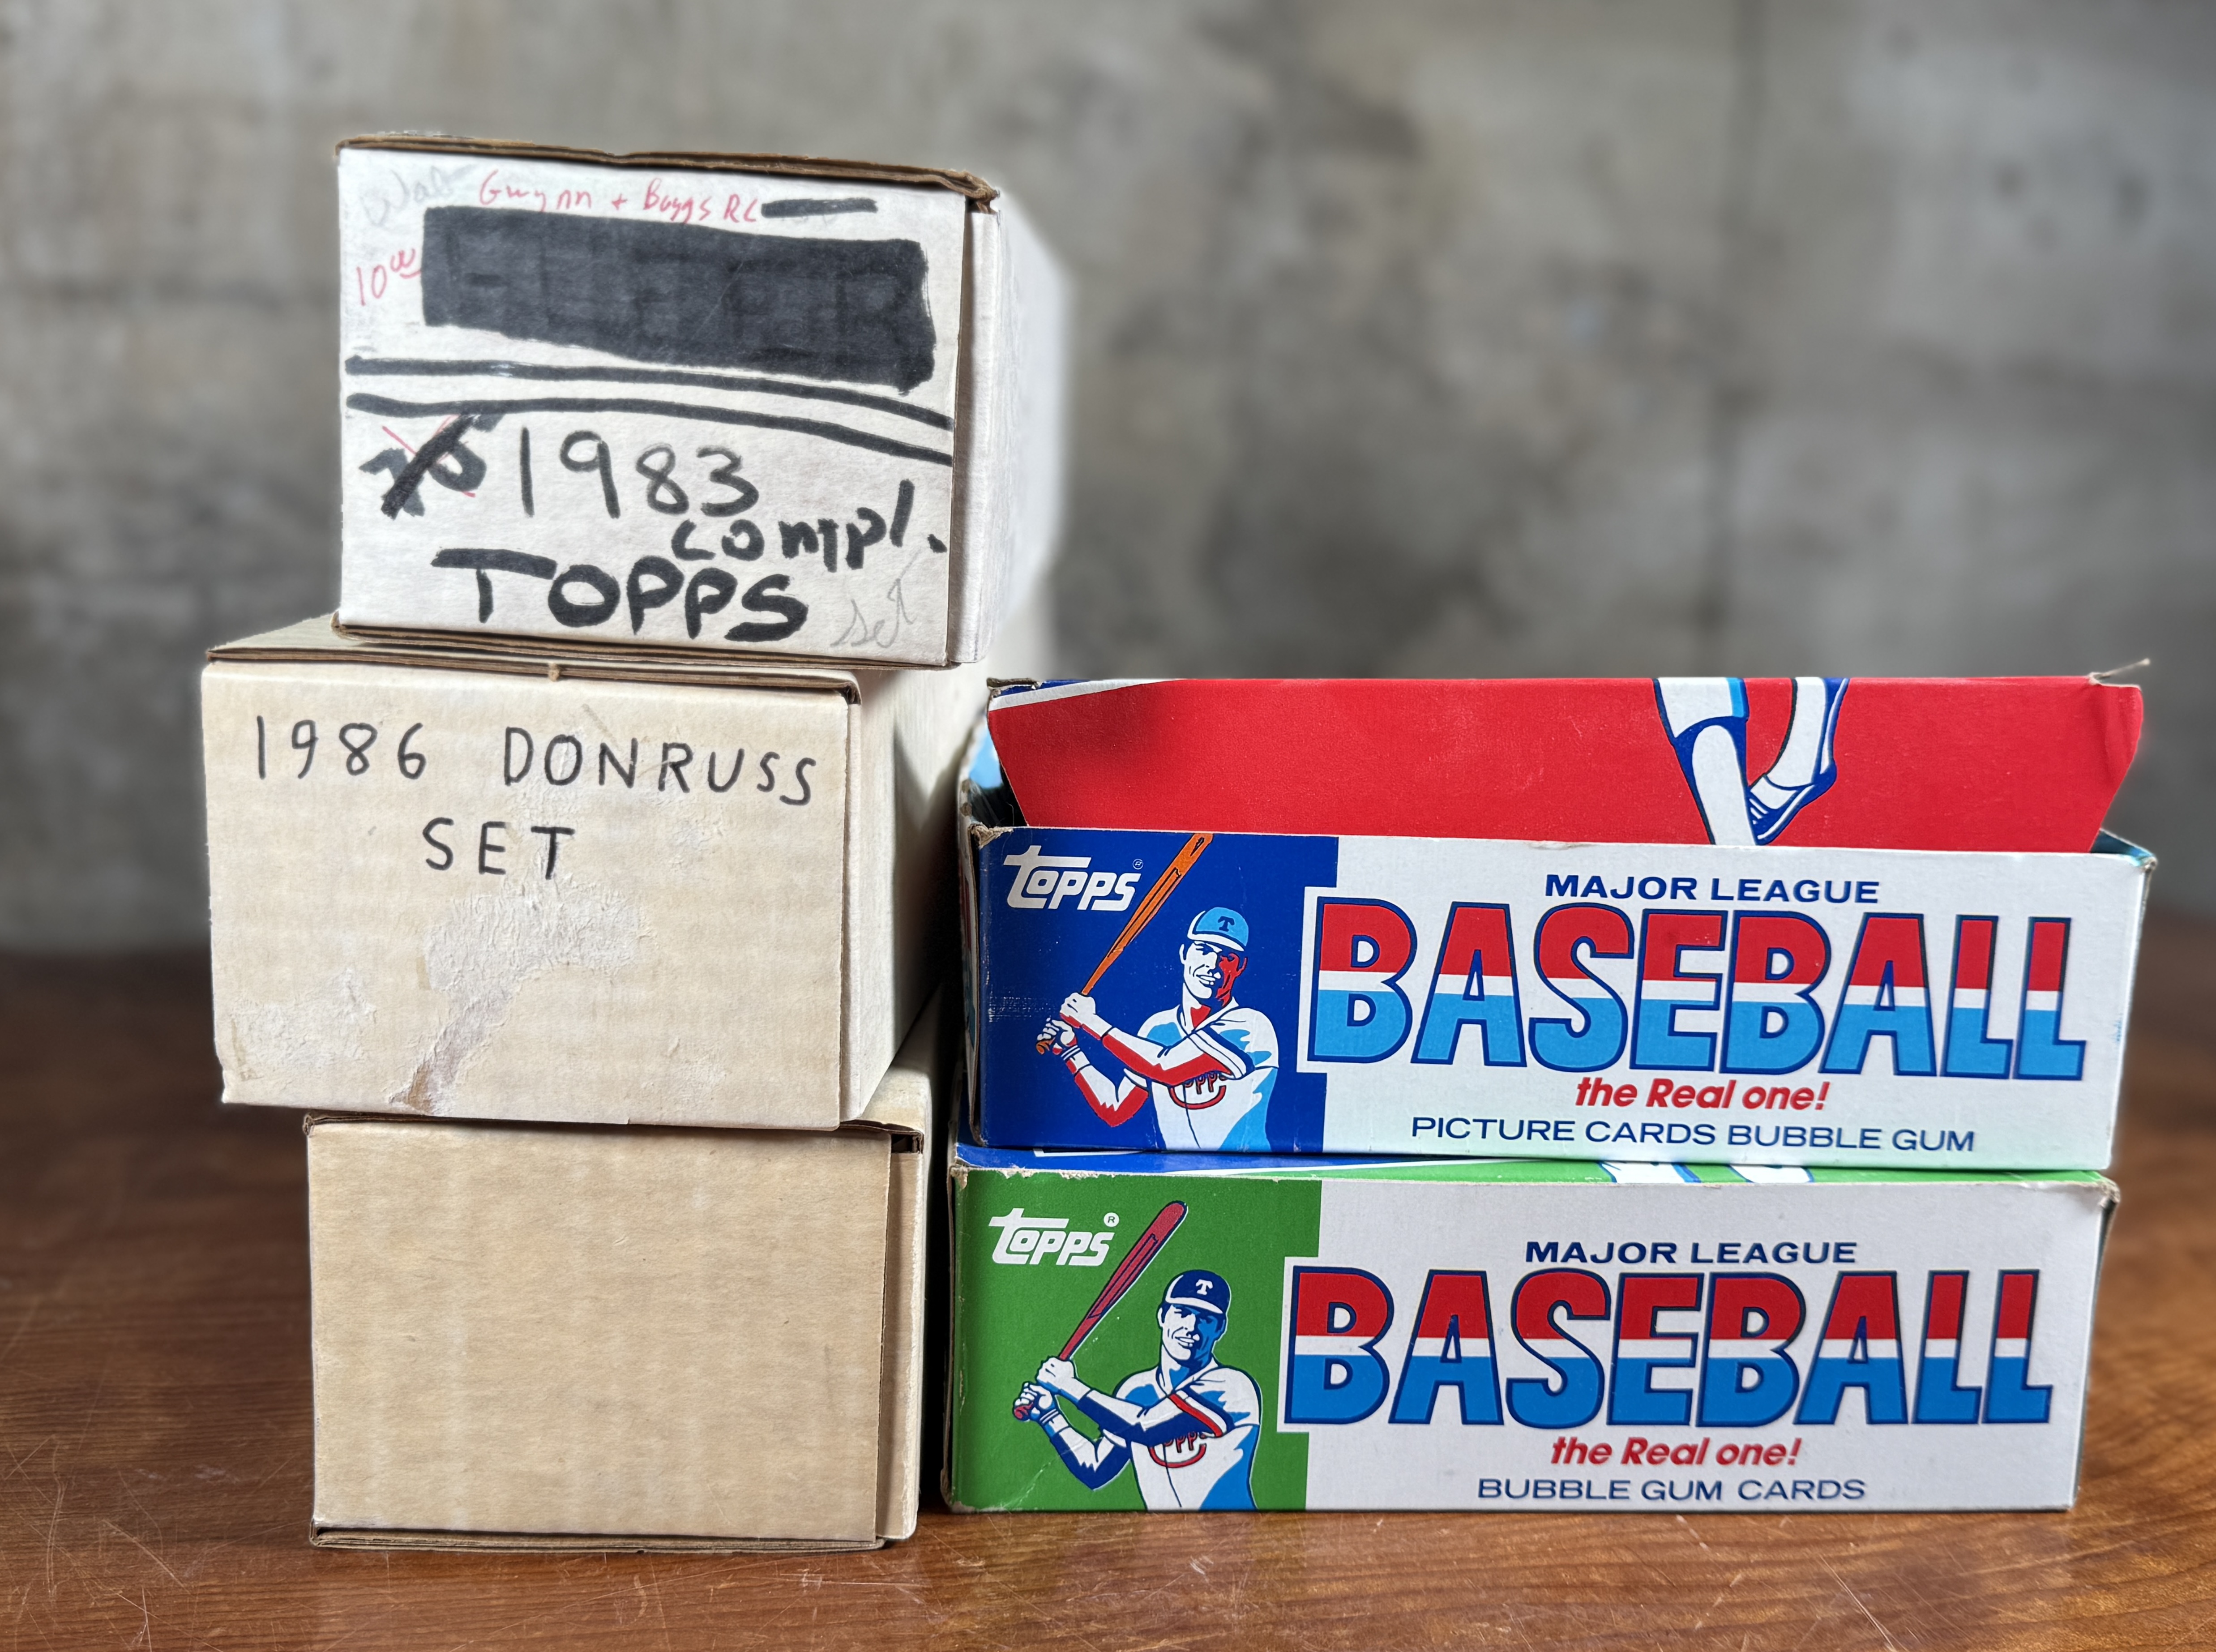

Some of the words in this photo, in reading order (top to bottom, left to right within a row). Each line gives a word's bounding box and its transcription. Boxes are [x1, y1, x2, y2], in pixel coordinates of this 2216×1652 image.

[479, 169, 592, 213] Gwynn
[518, 427, 759, 519] 1983
[431, 548, 809, 642] TOPPS
[256, 715, 427, 780] 1986
[503, 726, 817, 806] DONRUSS
[422, 817, 576, 880] SET
[1545, 874, 1698, 900] MAJOR
[1710, 877, 1880, 903] LEAGUE
[1307, 896, 2088, 1081] BASEBALL
[1575, 1077, 1638, 1107] the
[1645, 1077, 1737, 1108] Real
[1741, 1081, 1830, 1110] one!
[1411, 1117, 1575, 1141] PICTURE
[1585, 1120, 1716, 1145] CARDS
[1727, 1125, 1881, 1149] BUBBLE
[1891, 1129, 1975, 1152] GUM
[1525, 1241, 1677, 1264] MAJOR
[1690, 1241, 1857, 1264] LEAGUE
[1283, 1265, 2053, 1428] BASEBALL
[1550, 1437, 1612, 1465] the
[1620, 1437, 1711, 1466] Real
[1715, 1437, 1803, 1466] one!
[1477, 1478, 1631, 1500] BUBBLE
[1641, 1479, 1723, 1501] GUM
[1737, 1479, 1866, 1500] CARDS
